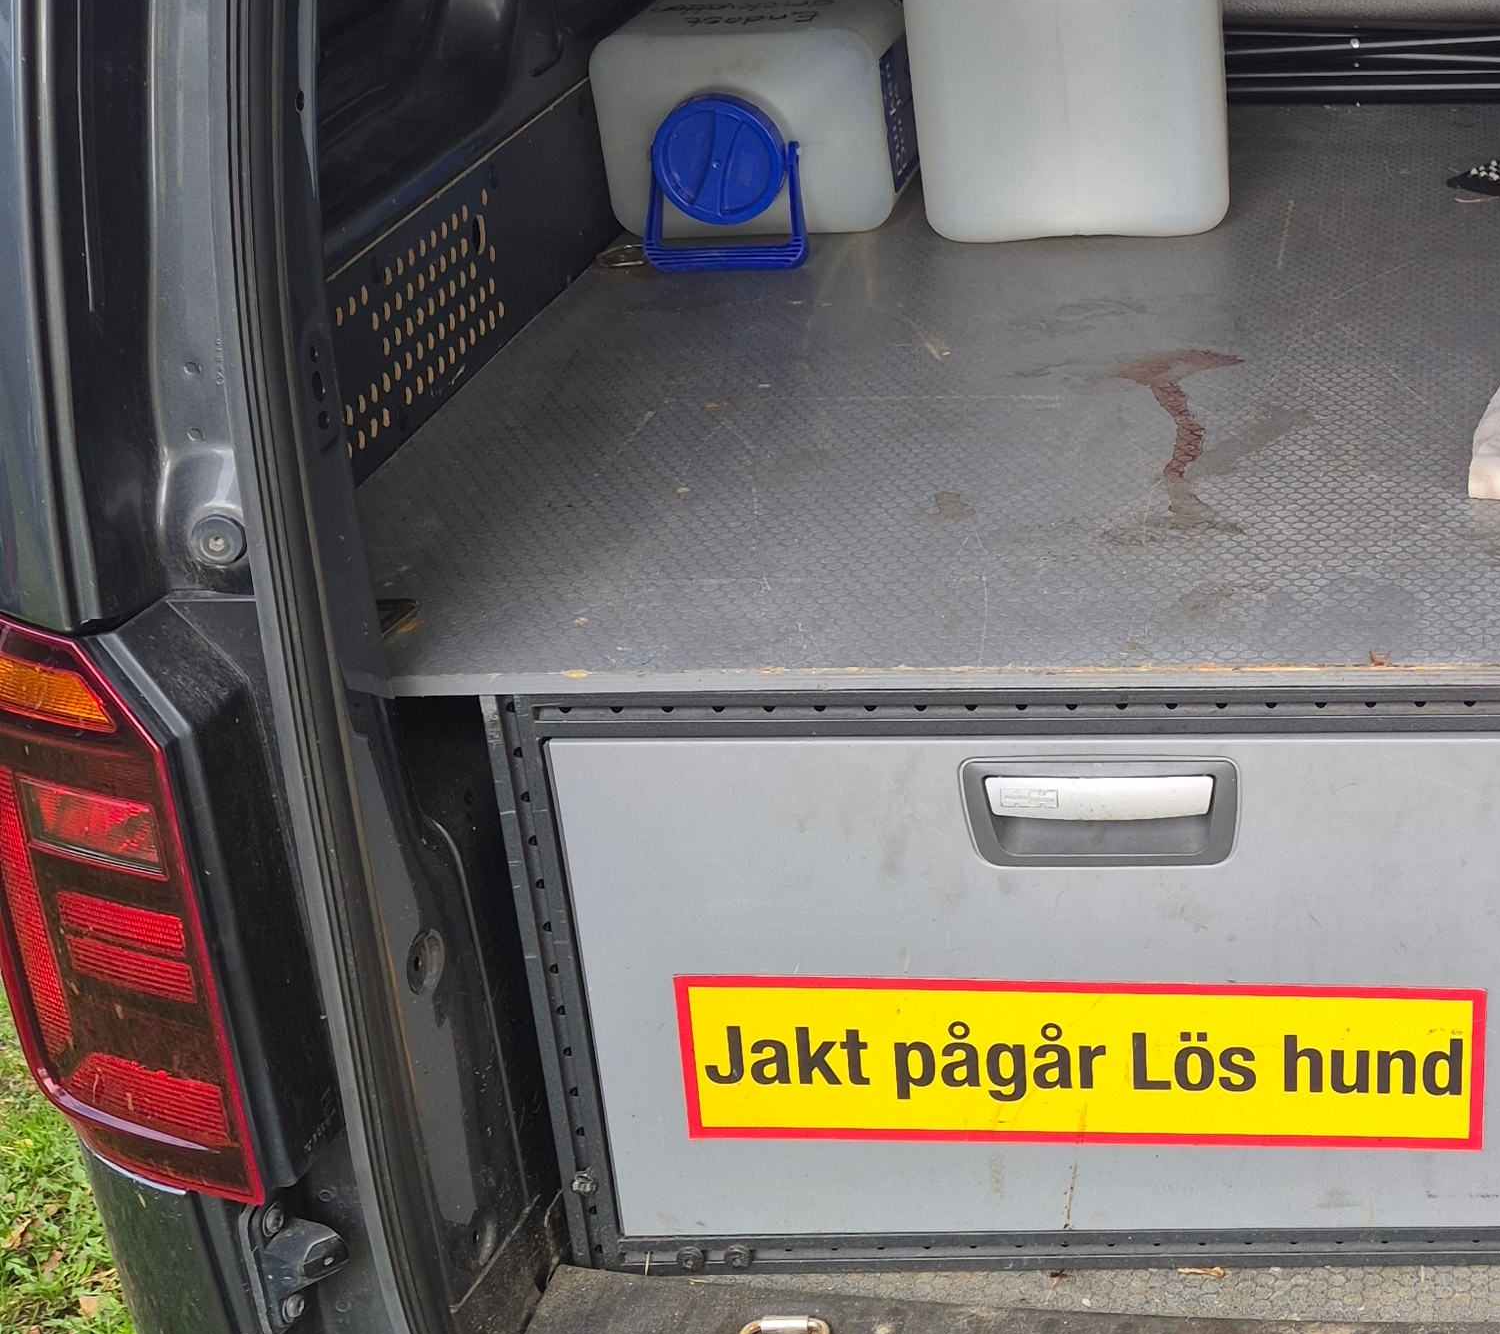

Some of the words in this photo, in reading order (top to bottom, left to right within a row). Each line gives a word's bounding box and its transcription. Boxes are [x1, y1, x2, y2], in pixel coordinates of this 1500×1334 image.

[704, 1025, 869, 1086] Jakt
[894, 1021, 1106, 1102] pågår
[1132, 1031, 1257, 1093] Lös
[1284, 1034, 1463, 1096] hund
